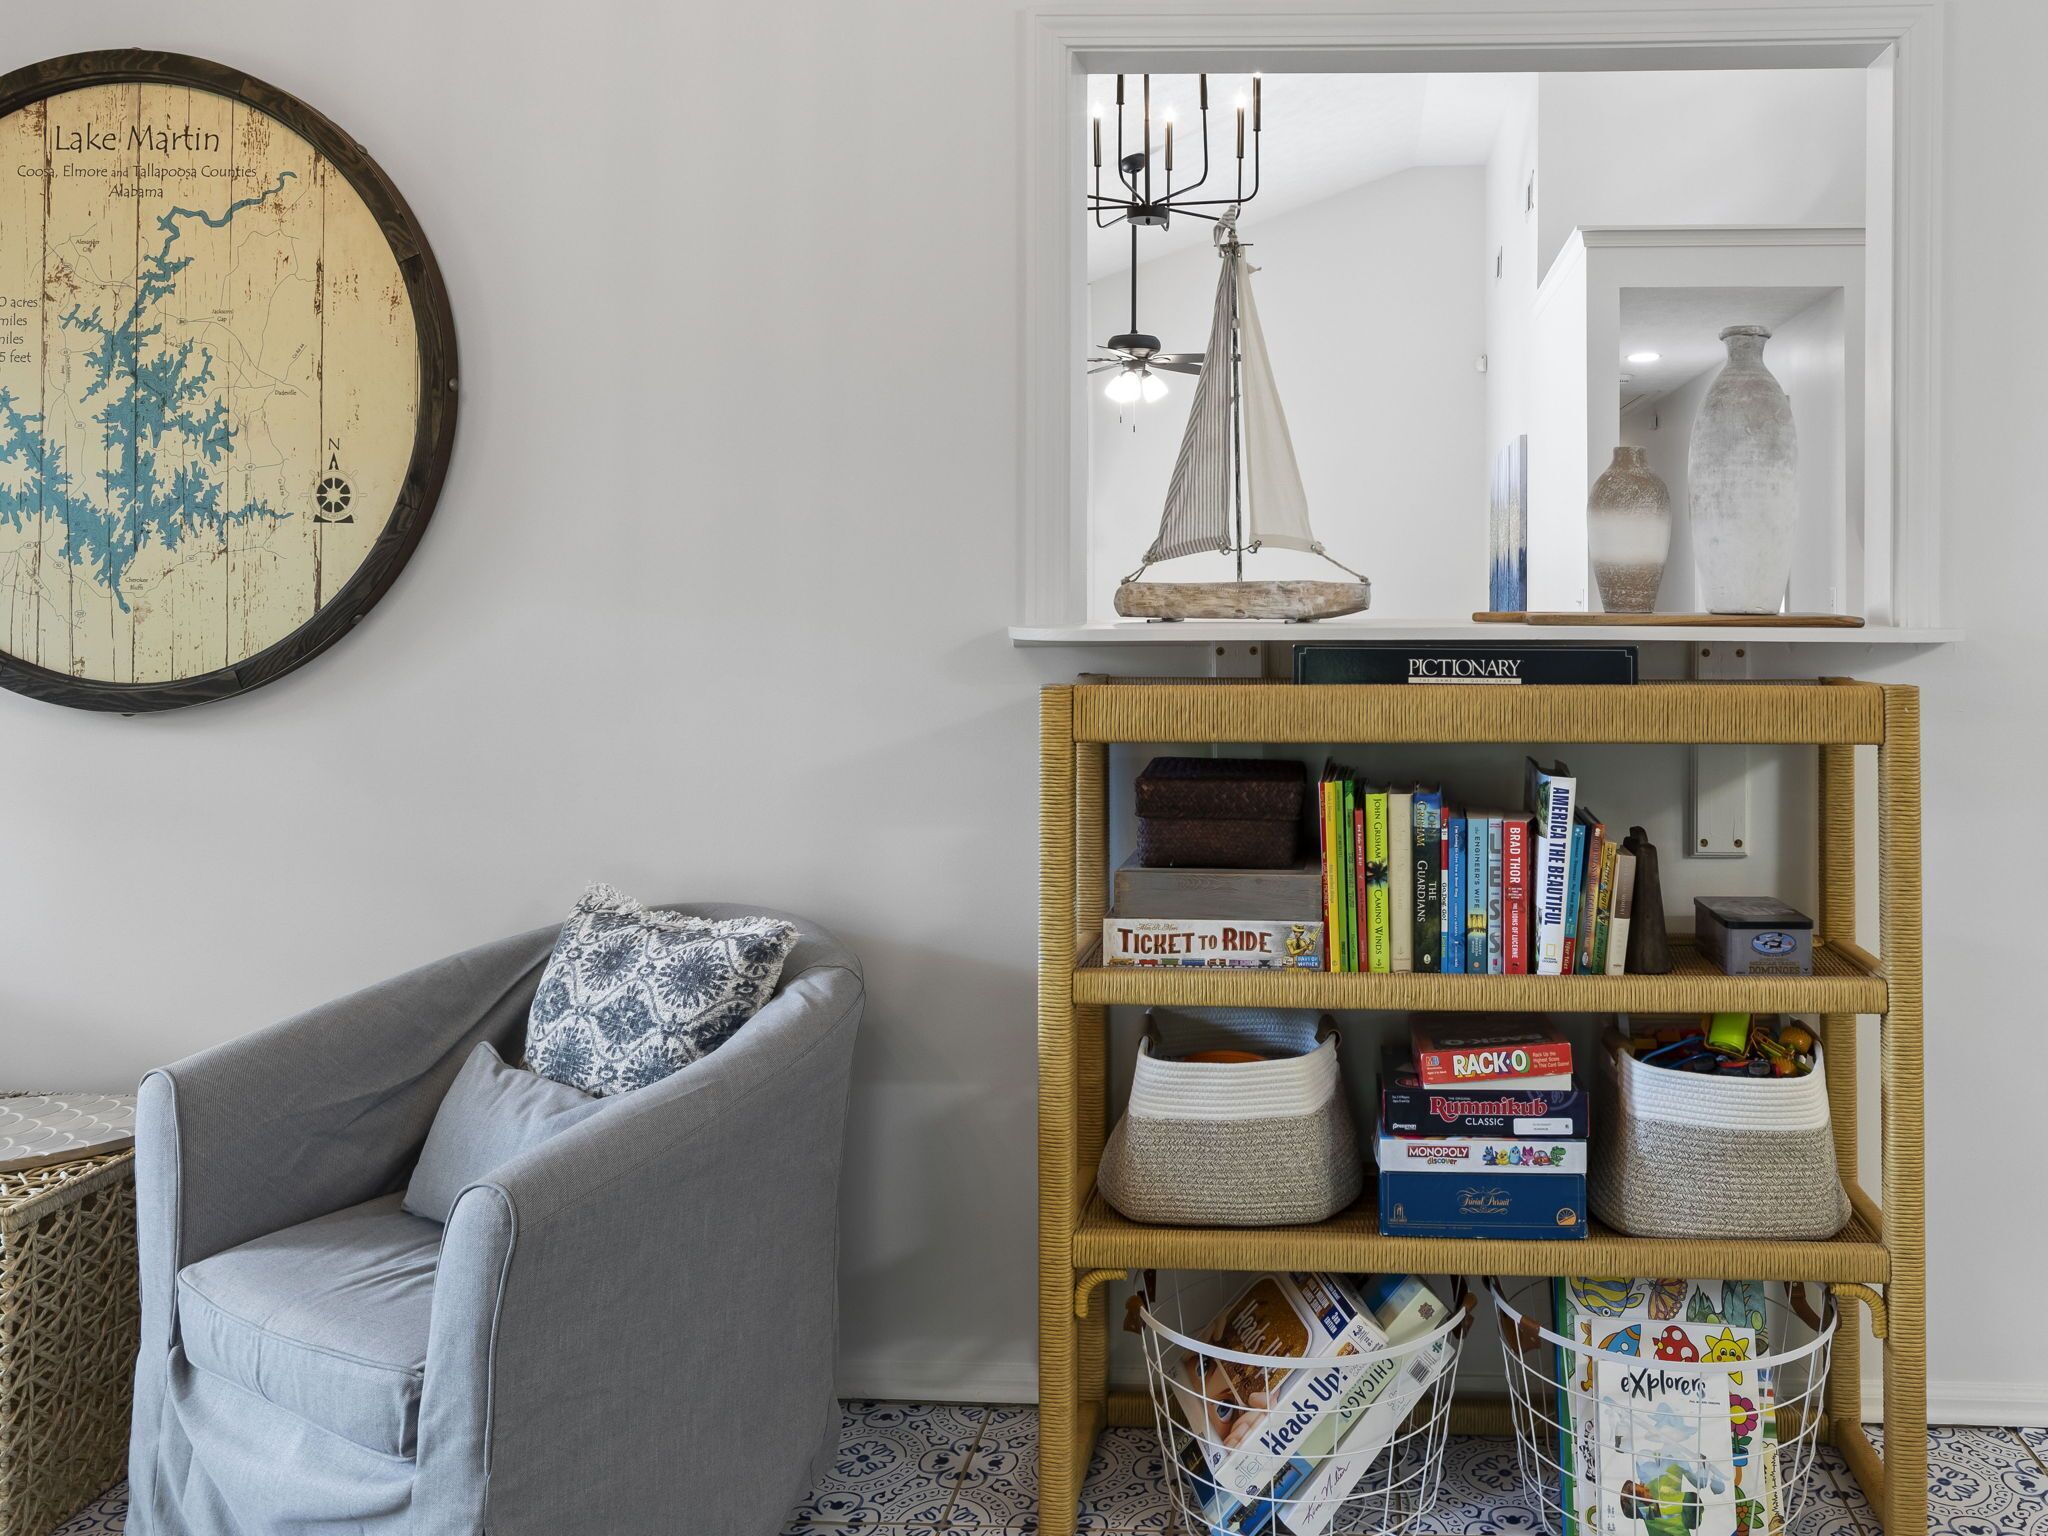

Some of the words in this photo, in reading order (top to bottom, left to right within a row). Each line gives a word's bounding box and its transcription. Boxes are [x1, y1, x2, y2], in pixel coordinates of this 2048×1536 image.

[55, 122, 117, 154] Lake
[127, 125, 220, 154] Martin
[17, 164, 58, 179] Coosa,
[63, 164, 108, 178] Elmore
[111, 167, 129, 178] and
[132, 164, 197, 179] Tallapoosa
[201, 164, 257, 178] Counties
[108, 183, 164, 199] Alabama
[10, 298, 38, 308] acres
[10, 349, 32, 363] feet
[328, 437, 340, 451] N
[1408, 658, 1521, 676] PICTIONARY
[1373, 798, 1382, 819] JOHN
[1549, 786, 1570, 839] AMERICA
[1416, 801, 1427, 847] GRISHAM
[1428, 811, 1437, 838] JOHN
[1374, 820, 1382, 859] GRISHAM
[1510, 827, 1520, 854] BRAD
[1548, 842, 1567, 865] THE
[1510, 857, 1520, 884] THOR
[1416, 860, 1429, 922] GUARDIANS
[1428, 881, 1437, 901] THE
[1544, 866, 1565, 926] BEAUTIFUL
[1375, 889, 1383, 925] CAMINO
[1117, 928, 1195, 955] TICKET
[1198, 935, 1218, 950] TO
[1222, 927, 1272, 953] RIDE
[1375, 925, 1384, 955] WINDS
[1749, 966, 1800, 975] DOMINOES
[1430, 1096, 1547, 1123] Rummikub
[1465, 1118, 1504, 1126] CLASSIC
[1409, 1147, 1468, 1157] MONOPOLY
[1427, 1157, 1458, 1165] discover
[1231, 1299, 1270, 1353] Heads
[1337, 1357, 1394, 1419] CHICAGO
[1260, 1400, 1319, 1455] Heads
[1308, 1366, 1349, 1401] Up!
